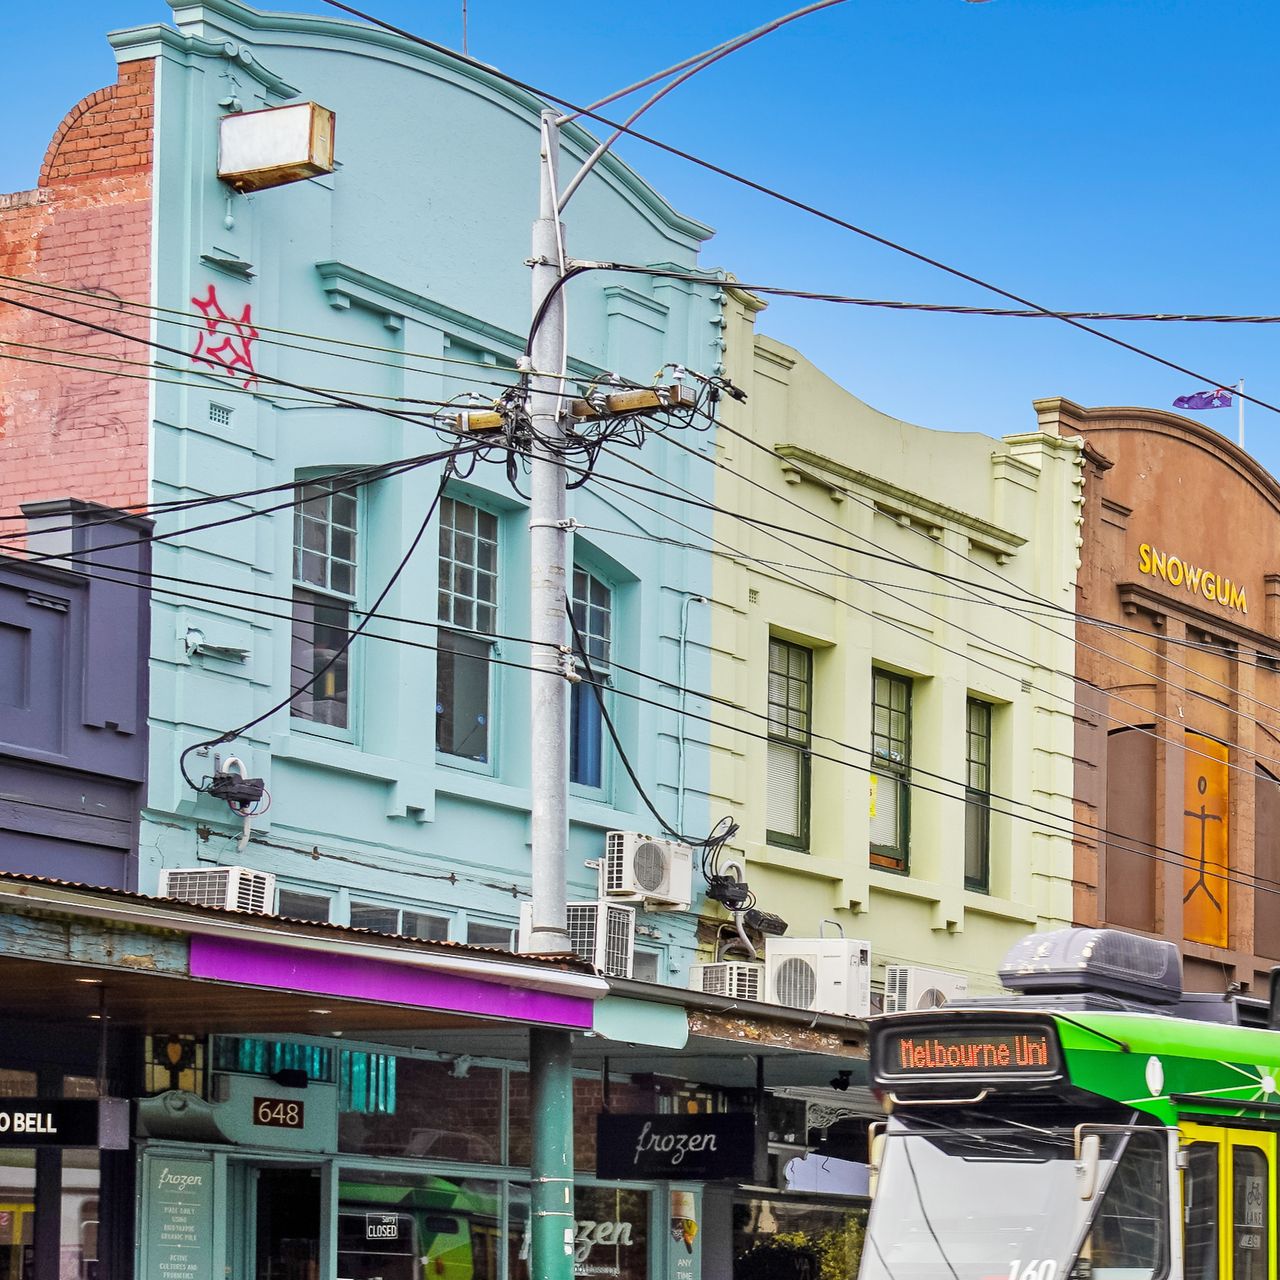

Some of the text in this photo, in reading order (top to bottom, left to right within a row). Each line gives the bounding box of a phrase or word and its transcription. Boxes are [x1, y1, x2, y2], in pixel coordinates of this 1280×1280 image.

[1139, 543, 1248, 614] SNOWGUM
[900, 1035, 1048, 1068] Melbourne Uni
[13, 1112, 57, 1133] BELL
[258, 1101, 299, 1125] 648
[633, 1121, 717, 1165] frozen
[158, 1167, 202, 1191] frozen
[368, 1225, 397, 1237] CLOSED
[677, 1259, 692, 1267] ANY
[677, 1272, 693, 1280] TIME
